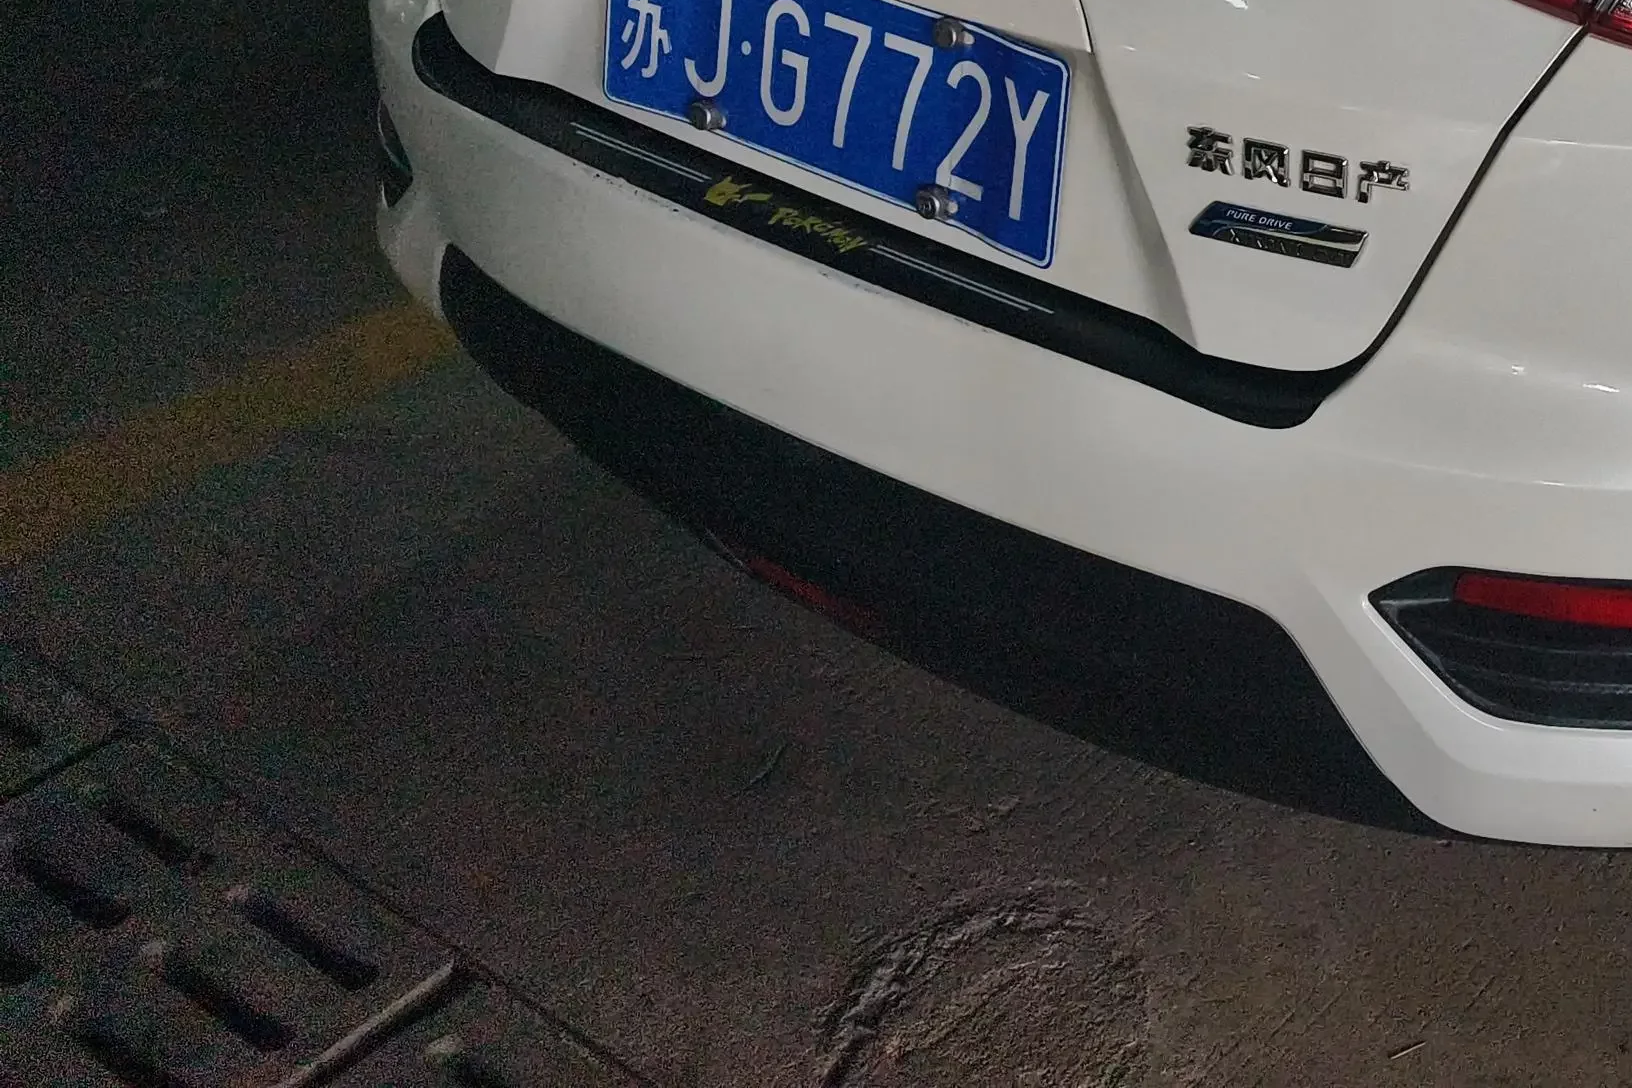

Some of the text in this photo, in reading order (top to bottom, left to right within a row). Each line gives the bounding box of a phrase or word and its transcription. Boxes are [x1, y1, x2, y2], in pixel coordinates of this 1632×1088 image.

[1186, 125, 1411, 204] 东风日产
[1225, 208, 1294, 231] PURE DRIVE
